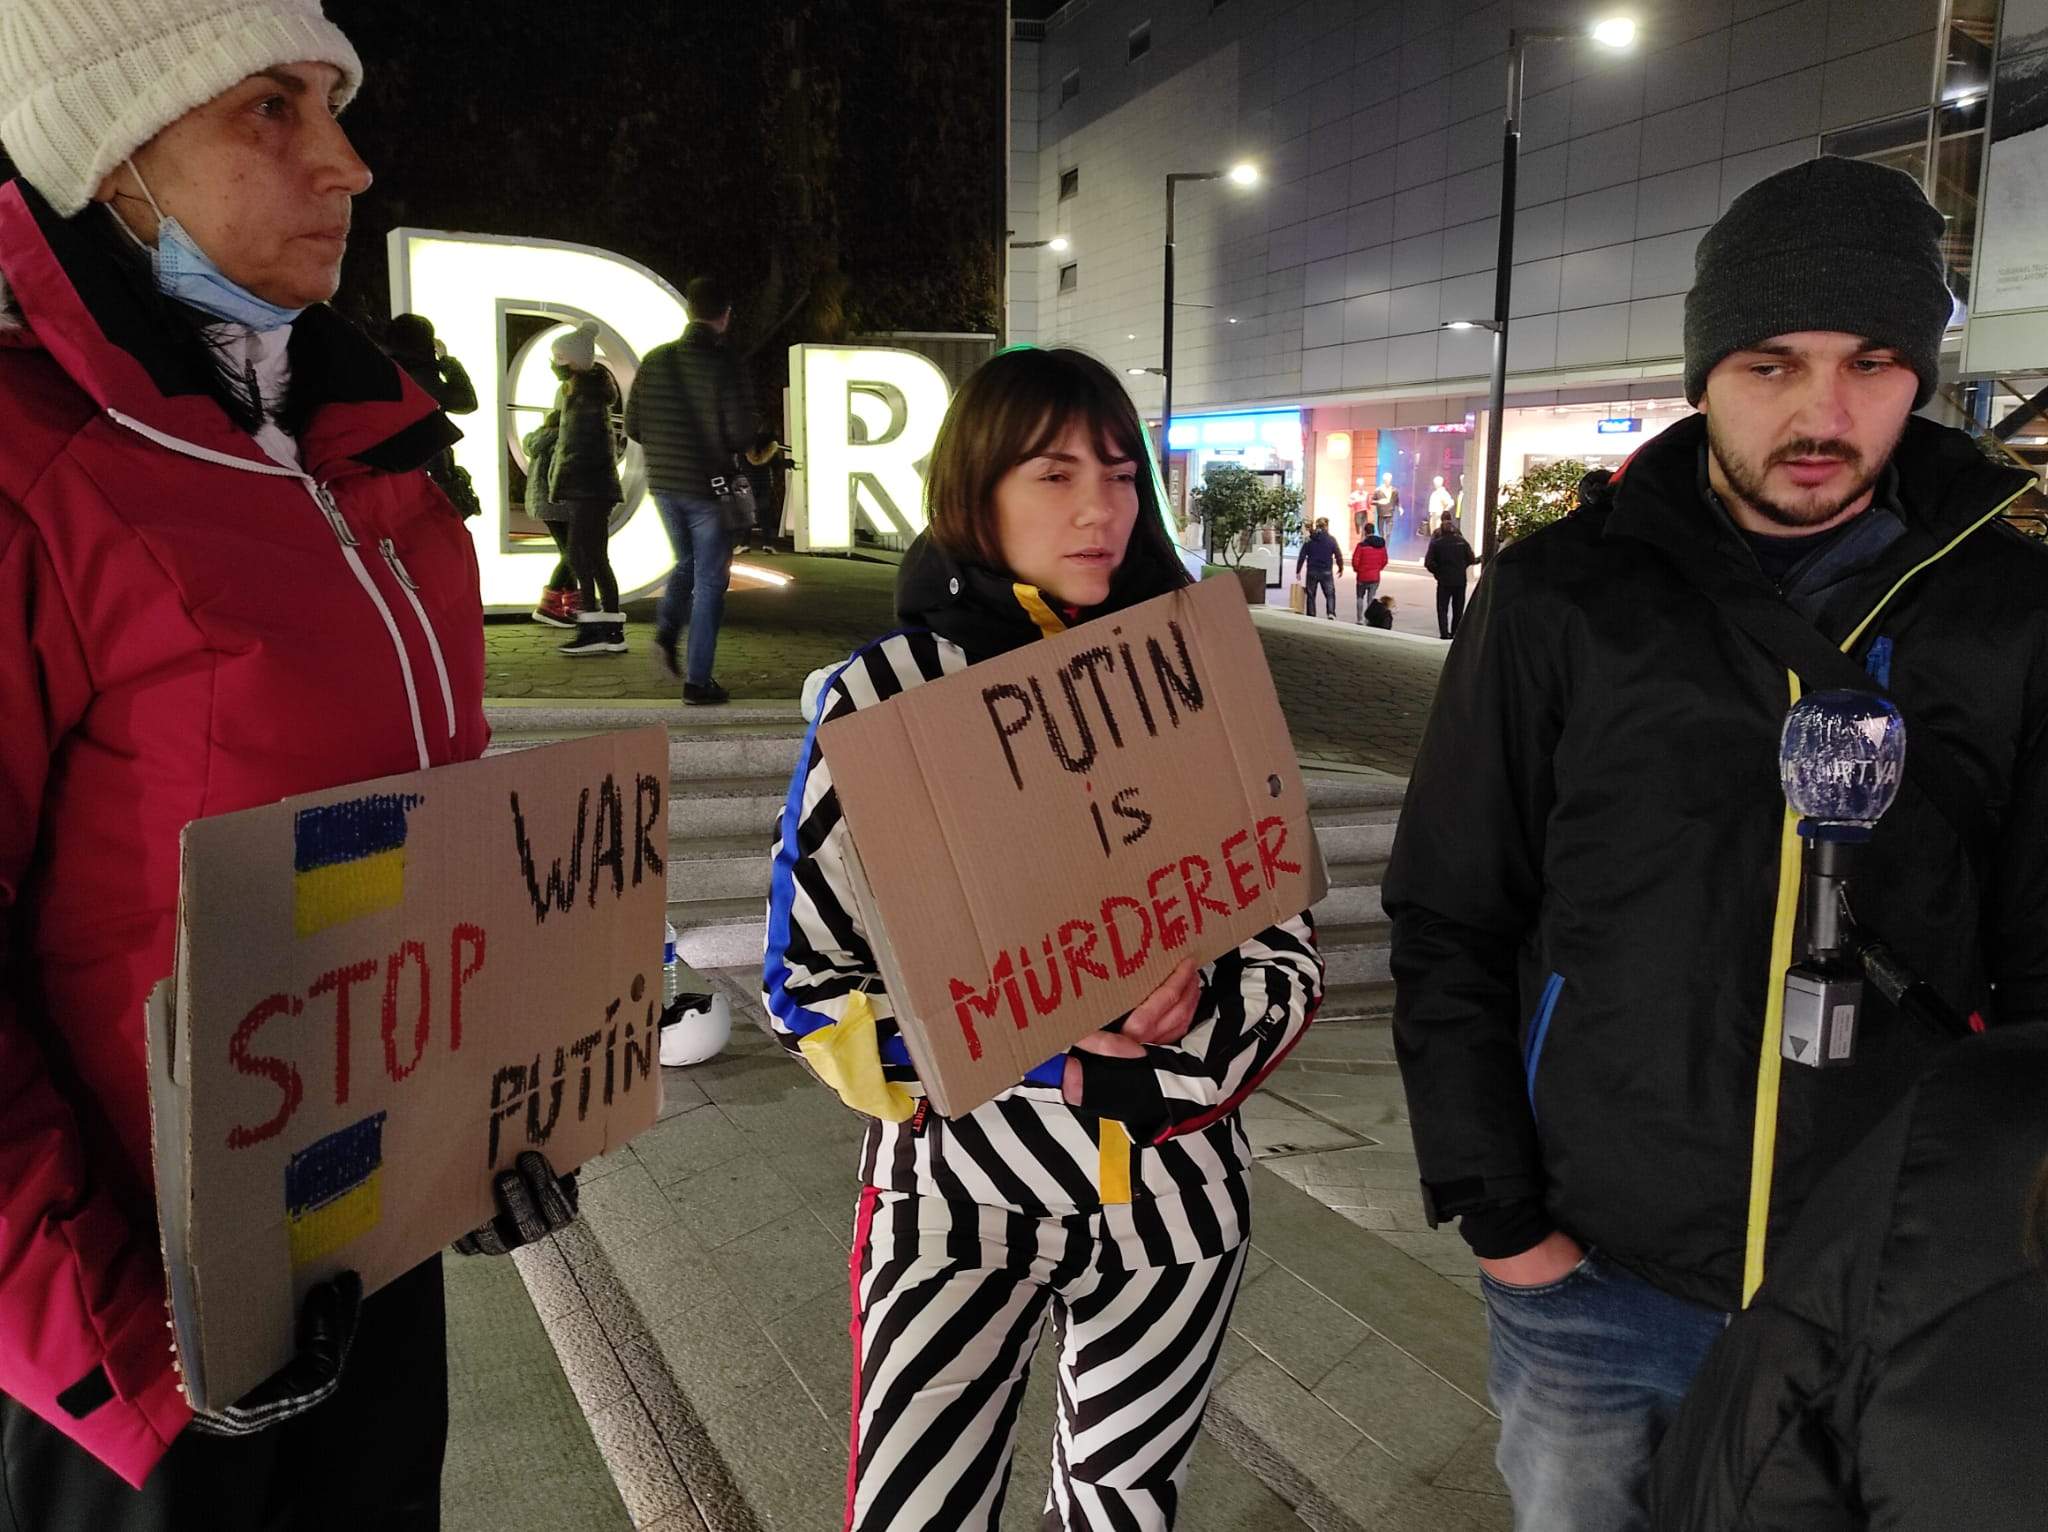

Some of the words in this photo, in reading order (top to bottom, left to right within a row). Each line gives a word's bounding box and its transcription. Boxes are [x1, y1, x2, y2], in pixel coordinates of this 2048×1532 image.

[510, 773, 664, 925] WAR
[949, 816, 1300, 1062] MURDERER
[226, 922, 486, 1149] STOP
